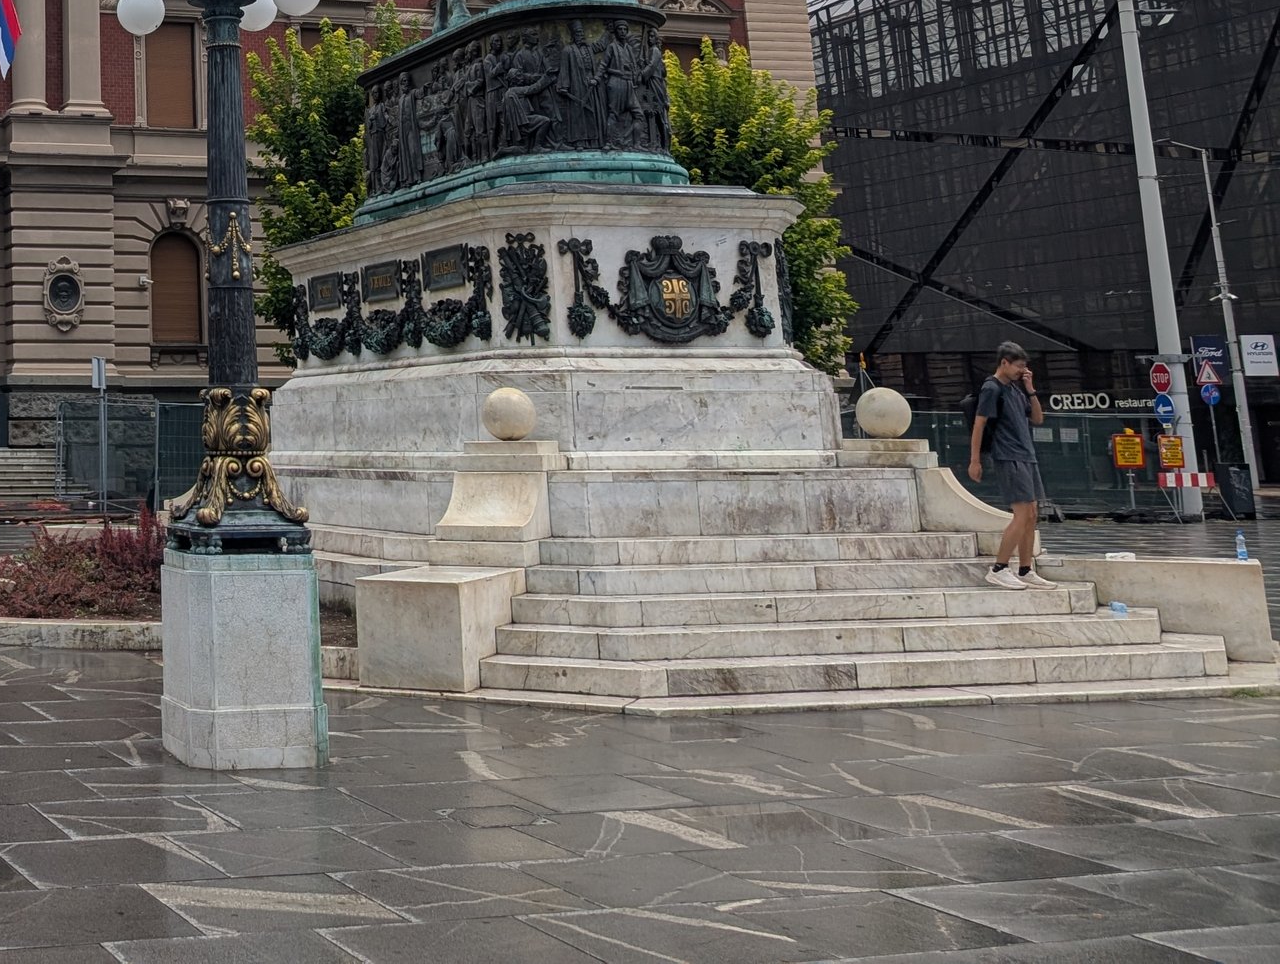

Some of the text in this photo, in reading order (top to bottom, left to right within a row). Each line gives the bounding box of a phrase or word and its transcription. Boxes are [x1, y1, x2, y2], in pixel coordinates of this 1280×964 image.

[1196, 346, 1223, 357] Ford
[1152, 373, 1169, 383] STOP
[1049, 393, 1110, 410] CREDO
